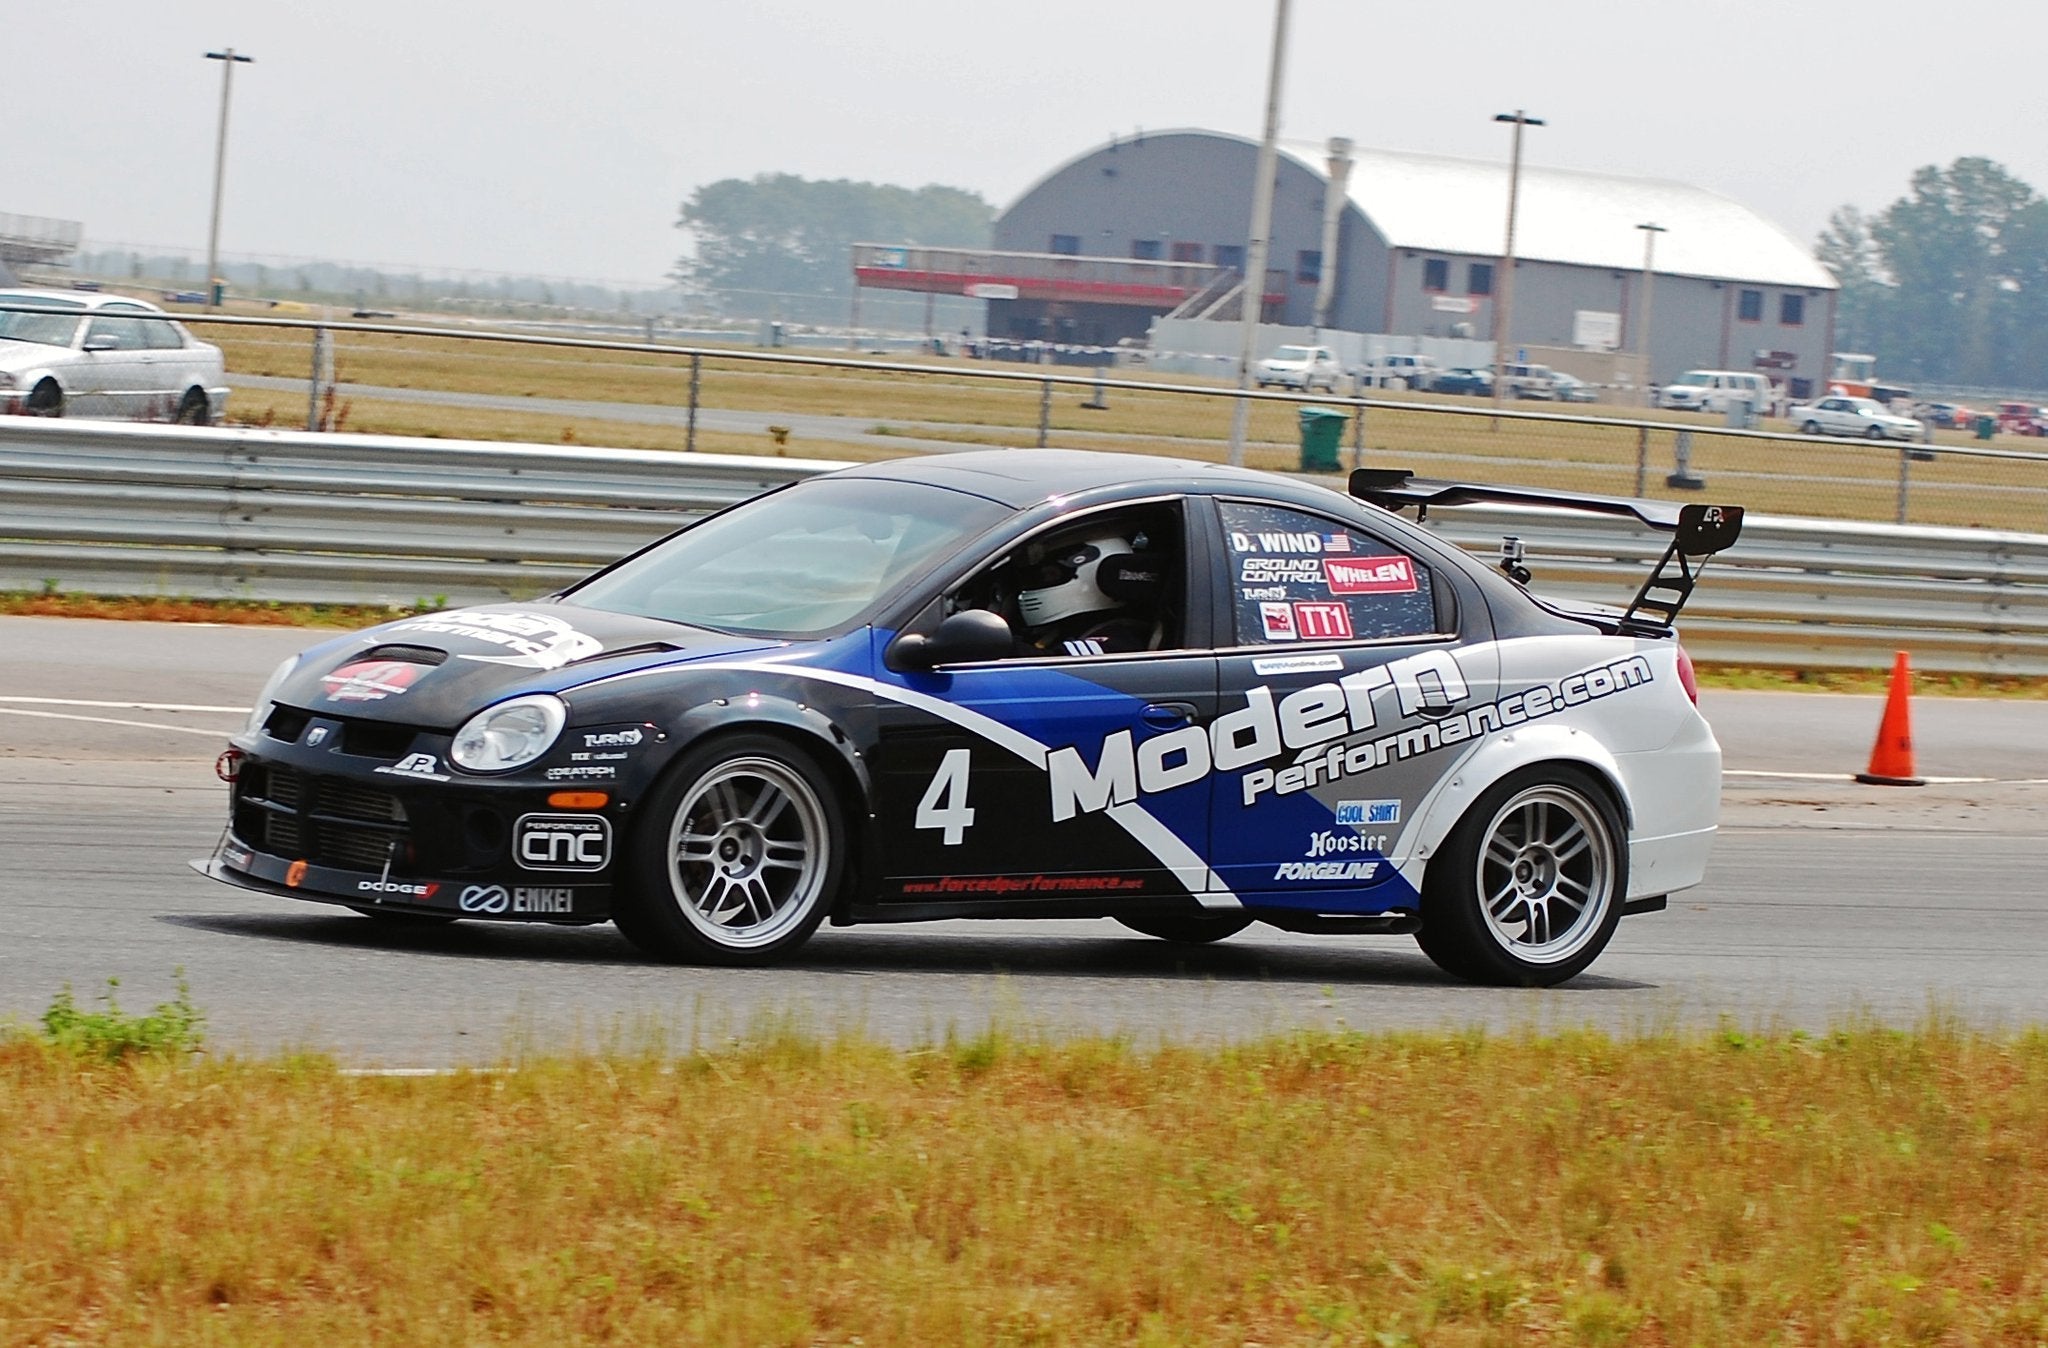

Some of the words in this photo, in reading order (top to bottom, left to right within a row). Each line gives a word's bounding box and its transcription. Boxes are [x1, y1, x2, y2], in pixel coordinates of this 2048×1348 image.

[1231, 533, 1257, 552] D.
[1258, 533, 1321, 552] WIND
[1242, 558, 1319, 571] GROUND
[1328, 562, 1408, 584] WHELEN
[1241, 570, 1328, 584] CONTROL
[1299, 606, 1347, 635] TT1
[1048, 649, 1470, 823] Modern
[1242, 655, 1653, 806] Performance.com
[914, 749, 975, 845] 4
[1338, 805, 1364, 823] COOL
[1368, 804, 1399, 822] SHIRT
[1304, 829, 1388, 858] Hoosier
[1273, 862, 1380, 881] FORGELINE
[357, 880, 429, 895] DODGE
[512, 887, 573, 914] ENKEI
